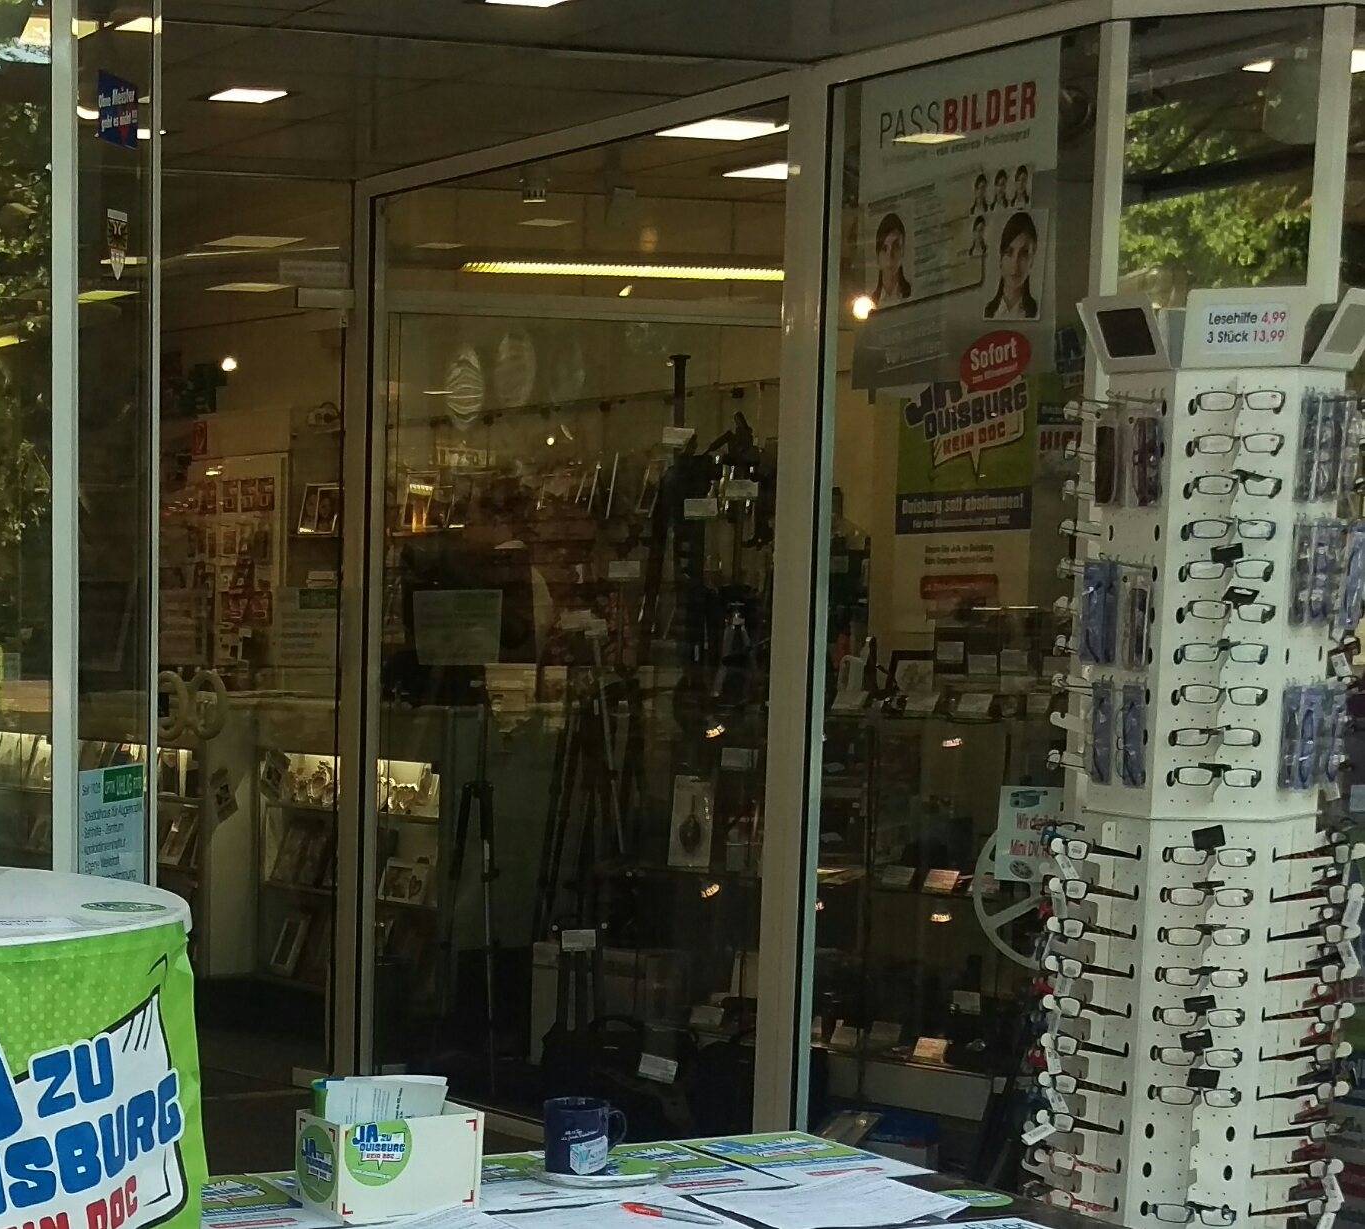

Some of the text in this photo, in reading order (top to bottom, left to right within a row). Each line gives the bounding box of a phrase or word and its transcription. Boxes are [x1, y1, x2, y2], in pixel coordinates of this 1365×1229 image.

[1208, 311, 1258, 326] Lesehilfe
[1206, 332, 1214, 344] 3
[1217, 330, 1249, 344] Stück
[970, 337, 1017, 371] Sofort
[924, 382, 1028, 440] DUISBURG
[943, 422, 1006, 455] KEIN DOC
[32, 1036, 114, 1118] ZU
[352, 1123, 379, 1145] JA
[86, 1175, 138, 1229] DOC
